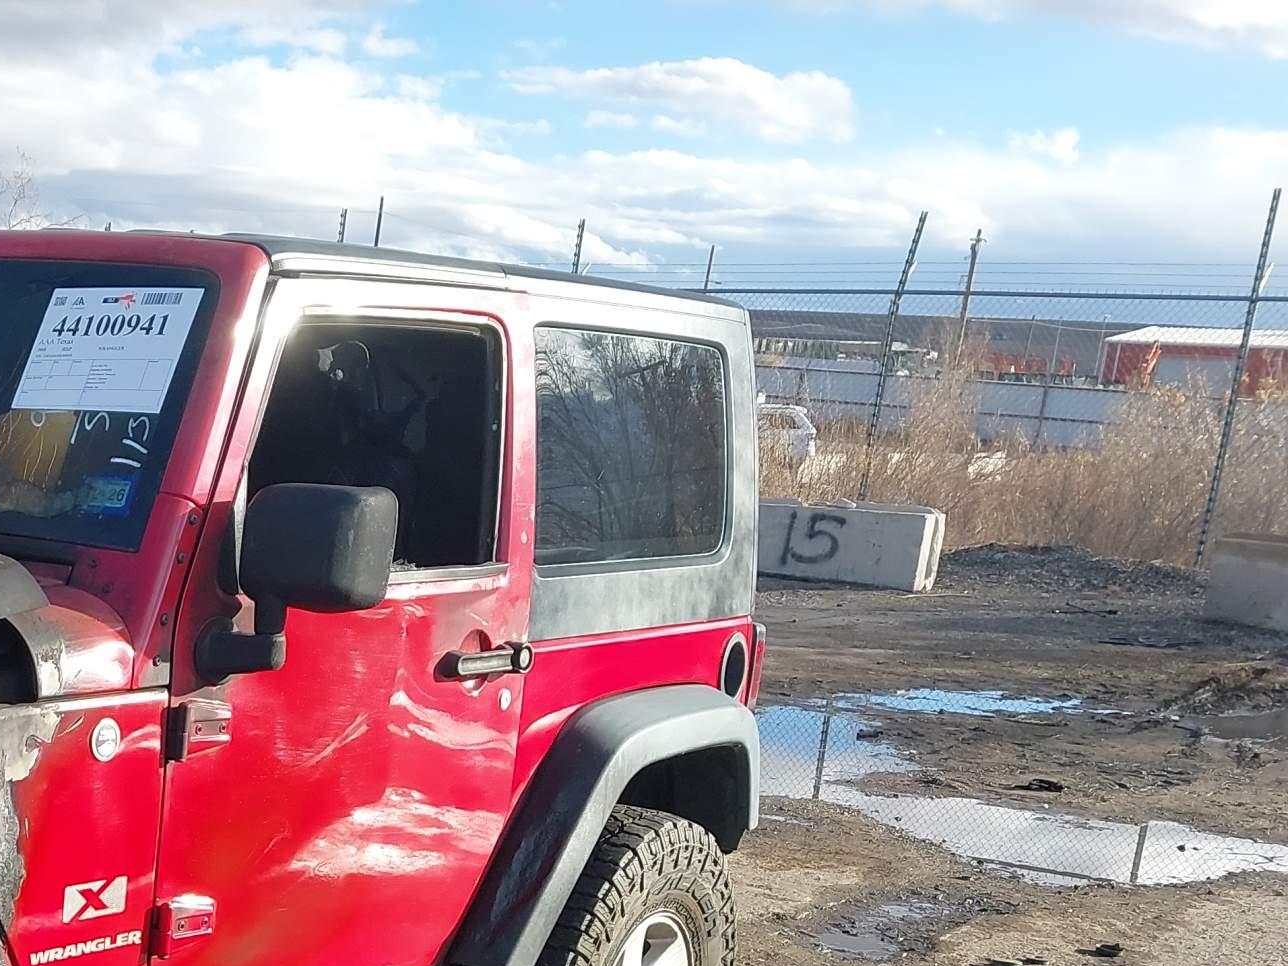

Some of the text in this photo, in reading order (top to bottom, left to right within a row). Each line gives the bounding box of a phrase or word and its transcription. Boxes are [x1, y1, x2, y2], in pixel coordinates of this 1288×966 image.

[52, 313, 170, 337] 44100941
[780, 510, 847, 566] 15
[63, 875, 128, 923] X
[30, 930, 142, 966] WRANGLER
